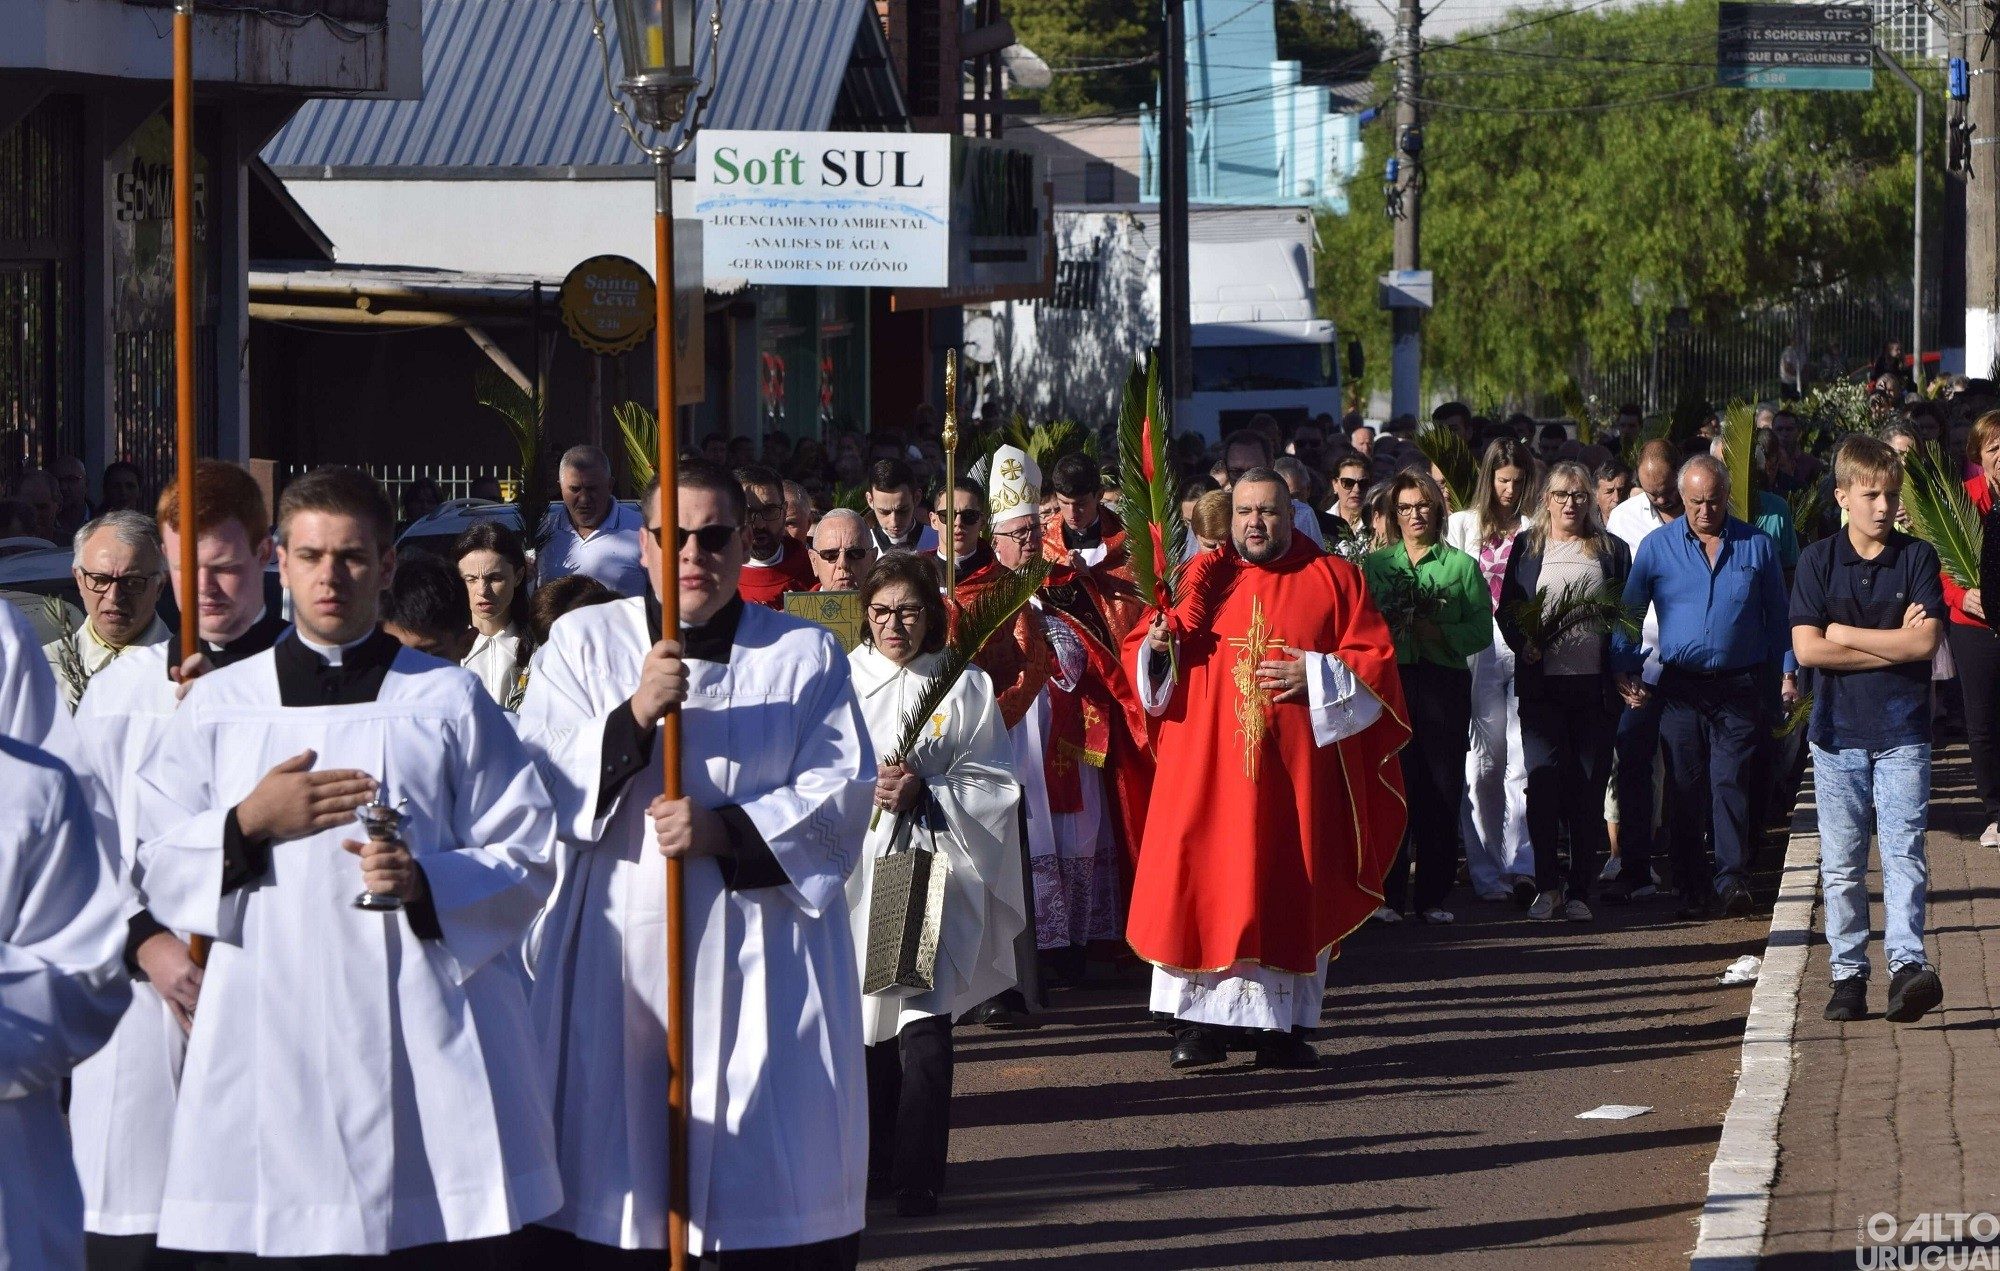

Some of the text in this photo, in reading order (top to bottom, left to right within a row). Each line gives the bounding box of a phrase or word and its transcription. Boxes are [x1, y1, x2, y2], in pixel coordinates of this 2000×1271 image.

[1774, 52, 1789, 62] DA
[714, 147, 924, 187] Soft SUL
[709, 215, 928, 230] -LICENCIAMENTO AMBIENTAL
[826, 239, 844, 249] DE
[850, 236, 890, 250] ÁGUA
[728, 258, 908, 272] -GERADORES DE OZÔNIO
[584, 274, 640, 291] Santa
[593, 291, 636, 307] Ceva
